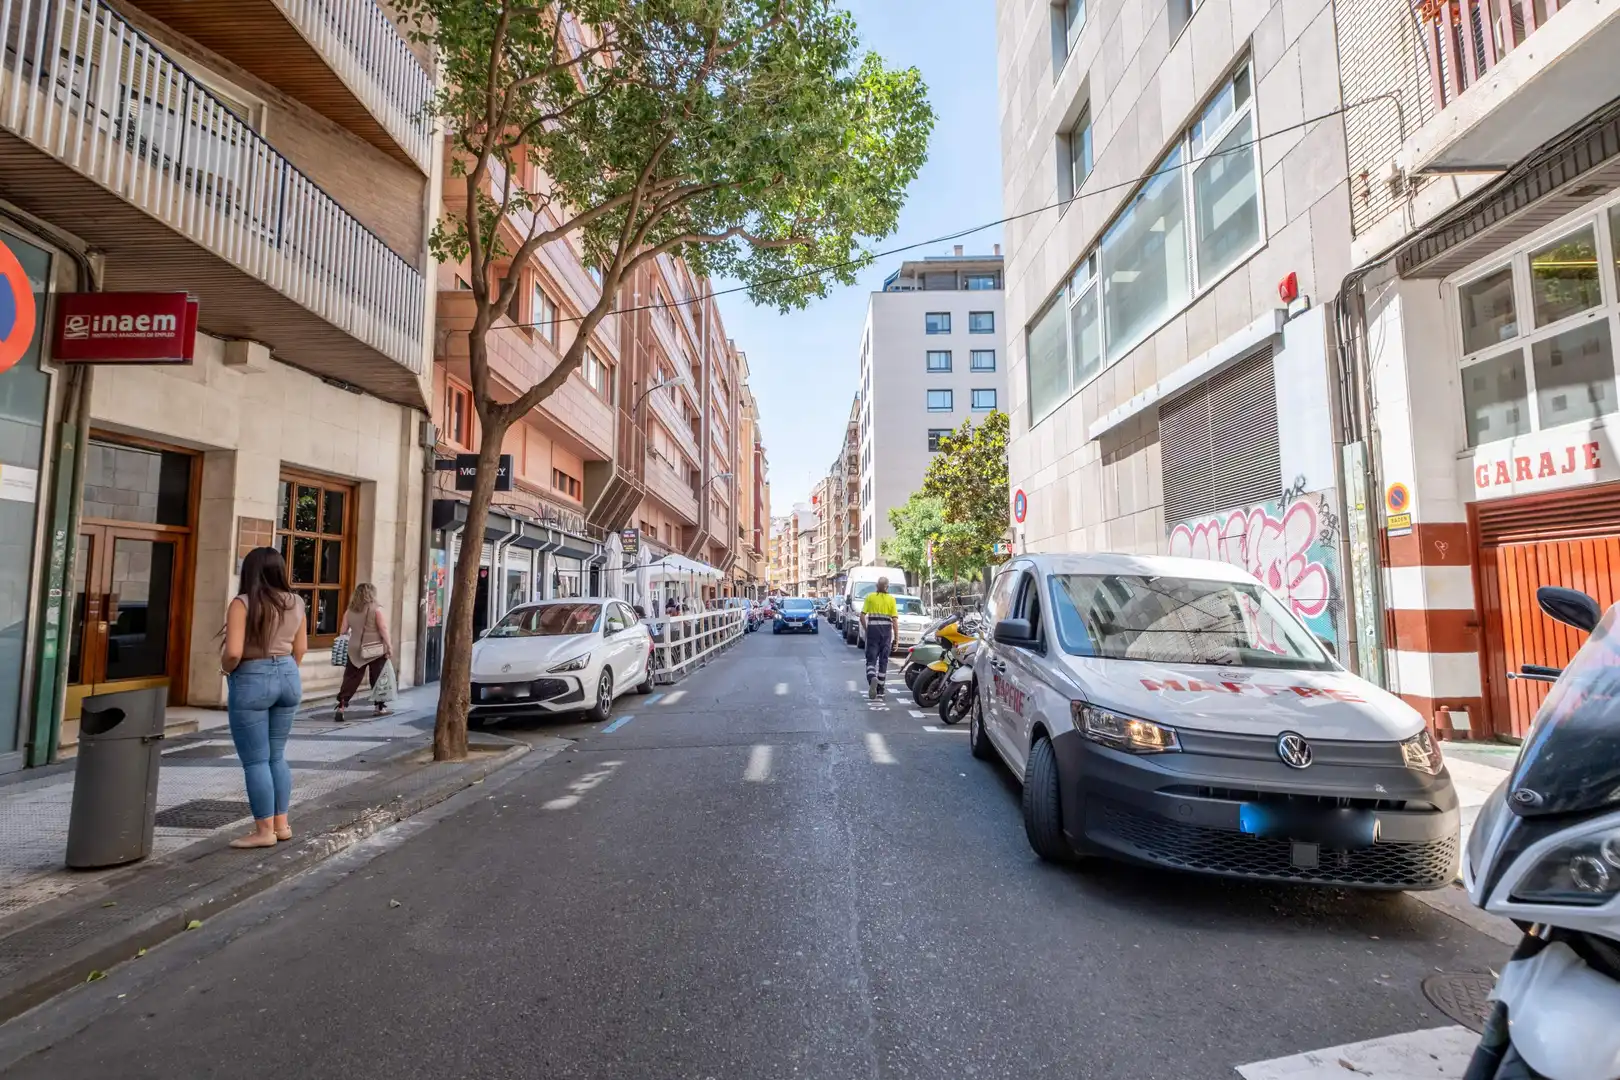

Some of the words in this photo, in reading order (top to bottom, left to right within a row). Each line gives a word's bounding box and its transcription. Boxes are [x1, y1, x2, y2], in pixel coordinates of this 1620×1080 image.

[92, 314, 176, 331] inaem
[1475, 442, 1602, 488] GARAJE
[994, 675, 1025, 717] MAPFRE
[1140, 679, 1367, 703] MAPFRE
